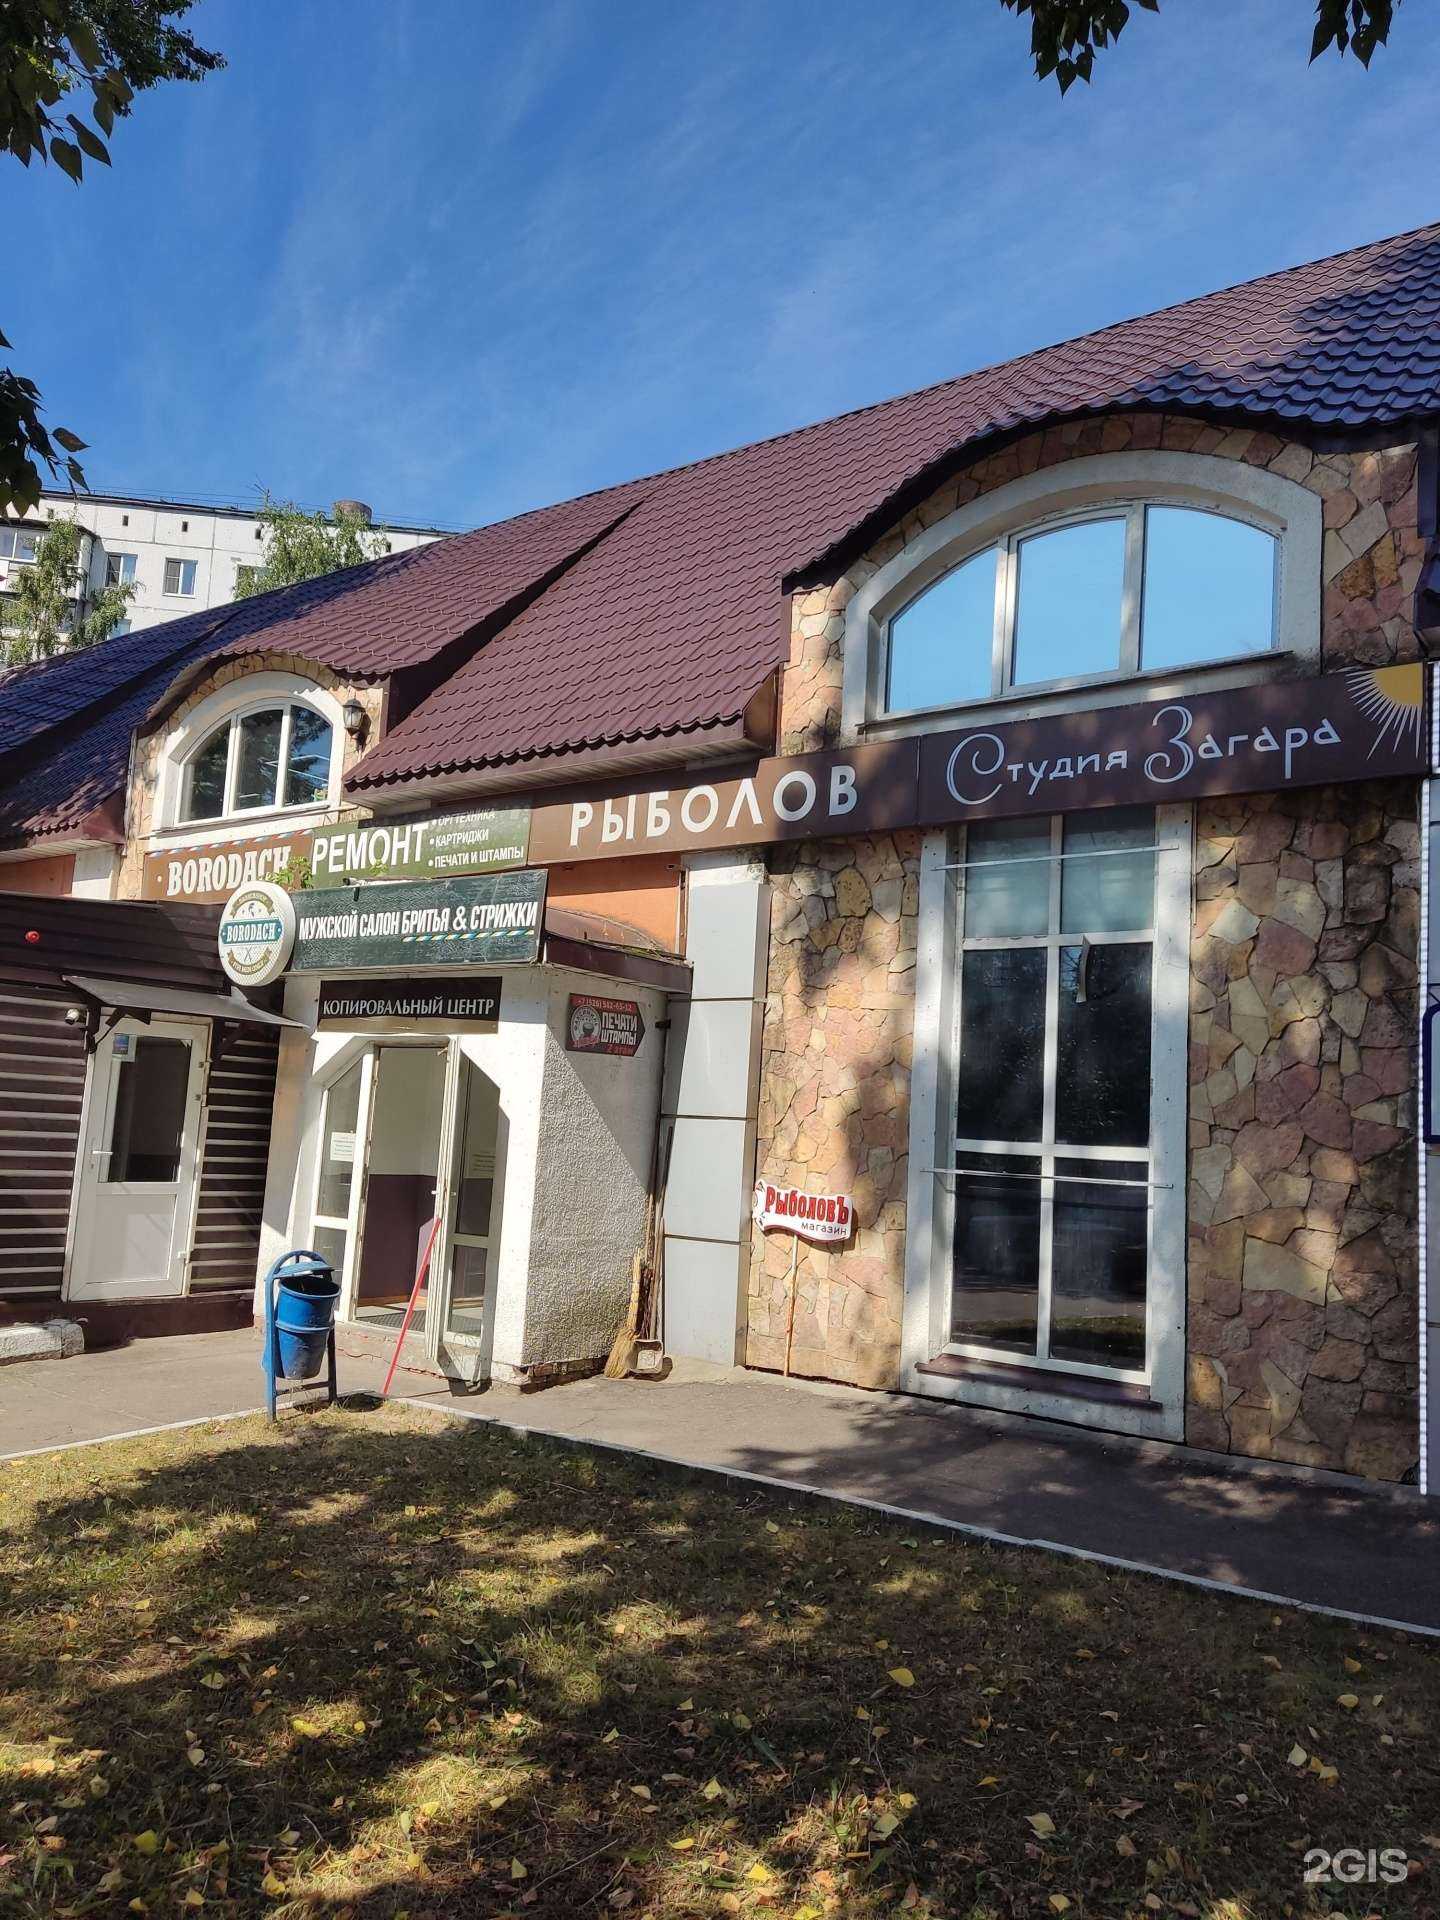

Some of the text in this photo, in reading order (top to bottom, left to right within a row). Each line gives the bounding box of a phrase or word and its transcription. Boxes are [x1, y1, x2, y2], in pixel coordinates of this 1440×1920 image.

[946, 705, 1342, 806] Студия Загара
[569, 765, 858, 848] РЫБОЛОВ
[312, 821, 429, 875] РЕМОНТ
[435, 829, 490, 847] КАРТРИДЖИ
[434, 846, 524, 869] ПЕЧАТИ И ШТАМПЫ
[167, 846, 291, 896] BORODACH
[299, 901, 538, 940] МУЖСКОЙ САЛОН БРИТЬЯ & СТРИЖКИ
[226, 922, 277, 942] BORODACH
[323, 995, 496, 1017] КОПИРОВАЛЬНЫЙ ЦЕНТР
[601, 1012, 638, 1031] ПЕЧАТИ
[600, 1029, 637, 1045] ШТАМПЫ
[801, 1222, 847, 1236] магазин
